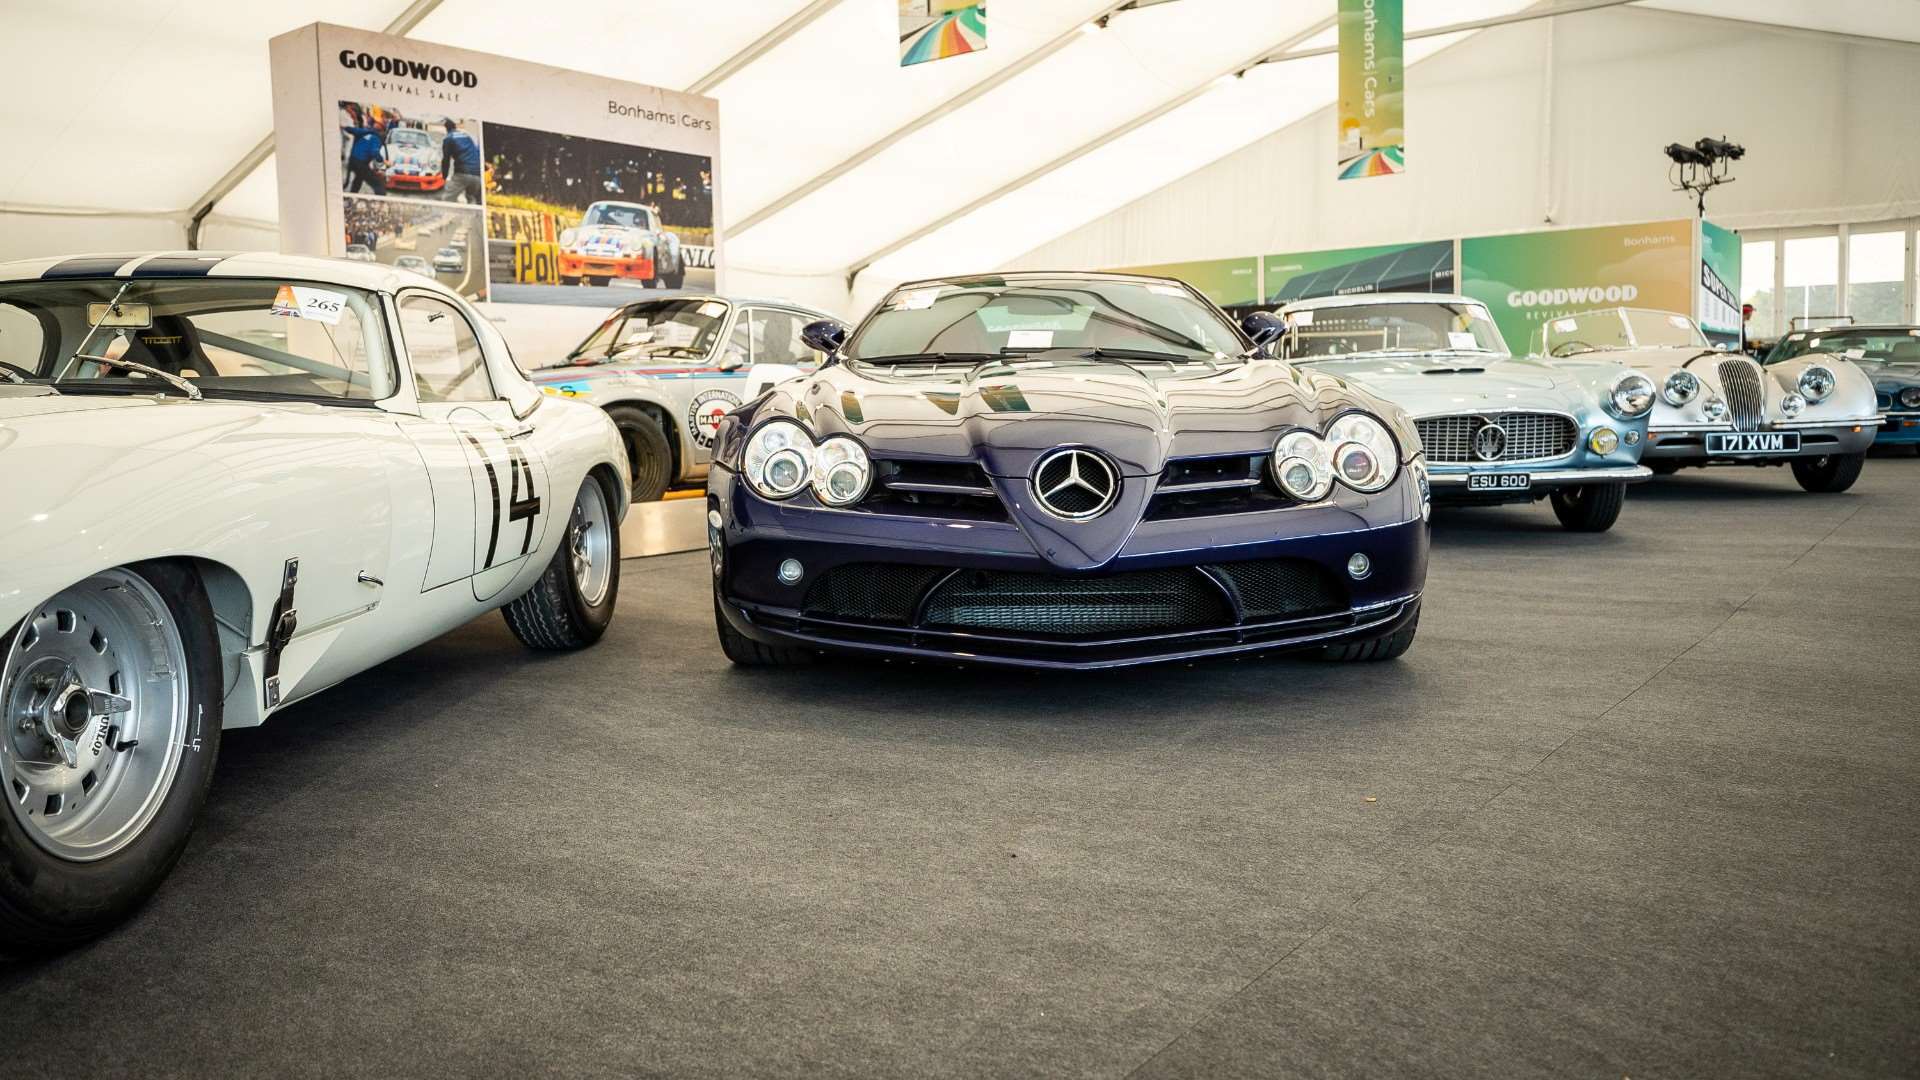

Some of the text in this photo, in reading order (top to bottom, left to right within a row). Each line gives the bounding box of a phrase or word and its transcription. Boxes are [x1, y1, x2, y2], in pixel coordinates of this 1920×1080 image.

[339, 50, 478, 88] GOODWOOD
[1364, 0, 1378, 118] onhams Cars
[364, 80, 459, 102] REVIVAL SALE
[608, 100, 712, 130] Bonhams Cars
[1624, 234, 1676, 248] Bonhams
[307, 298, 340, 313] 265
[1507, 285, 1638, 308] GOODWOOD
[1722, 434, 1784, 451] 171 XVM
[1471, 475, 1527, 487] ESU 600
[460, 429, 541, 570] 14
